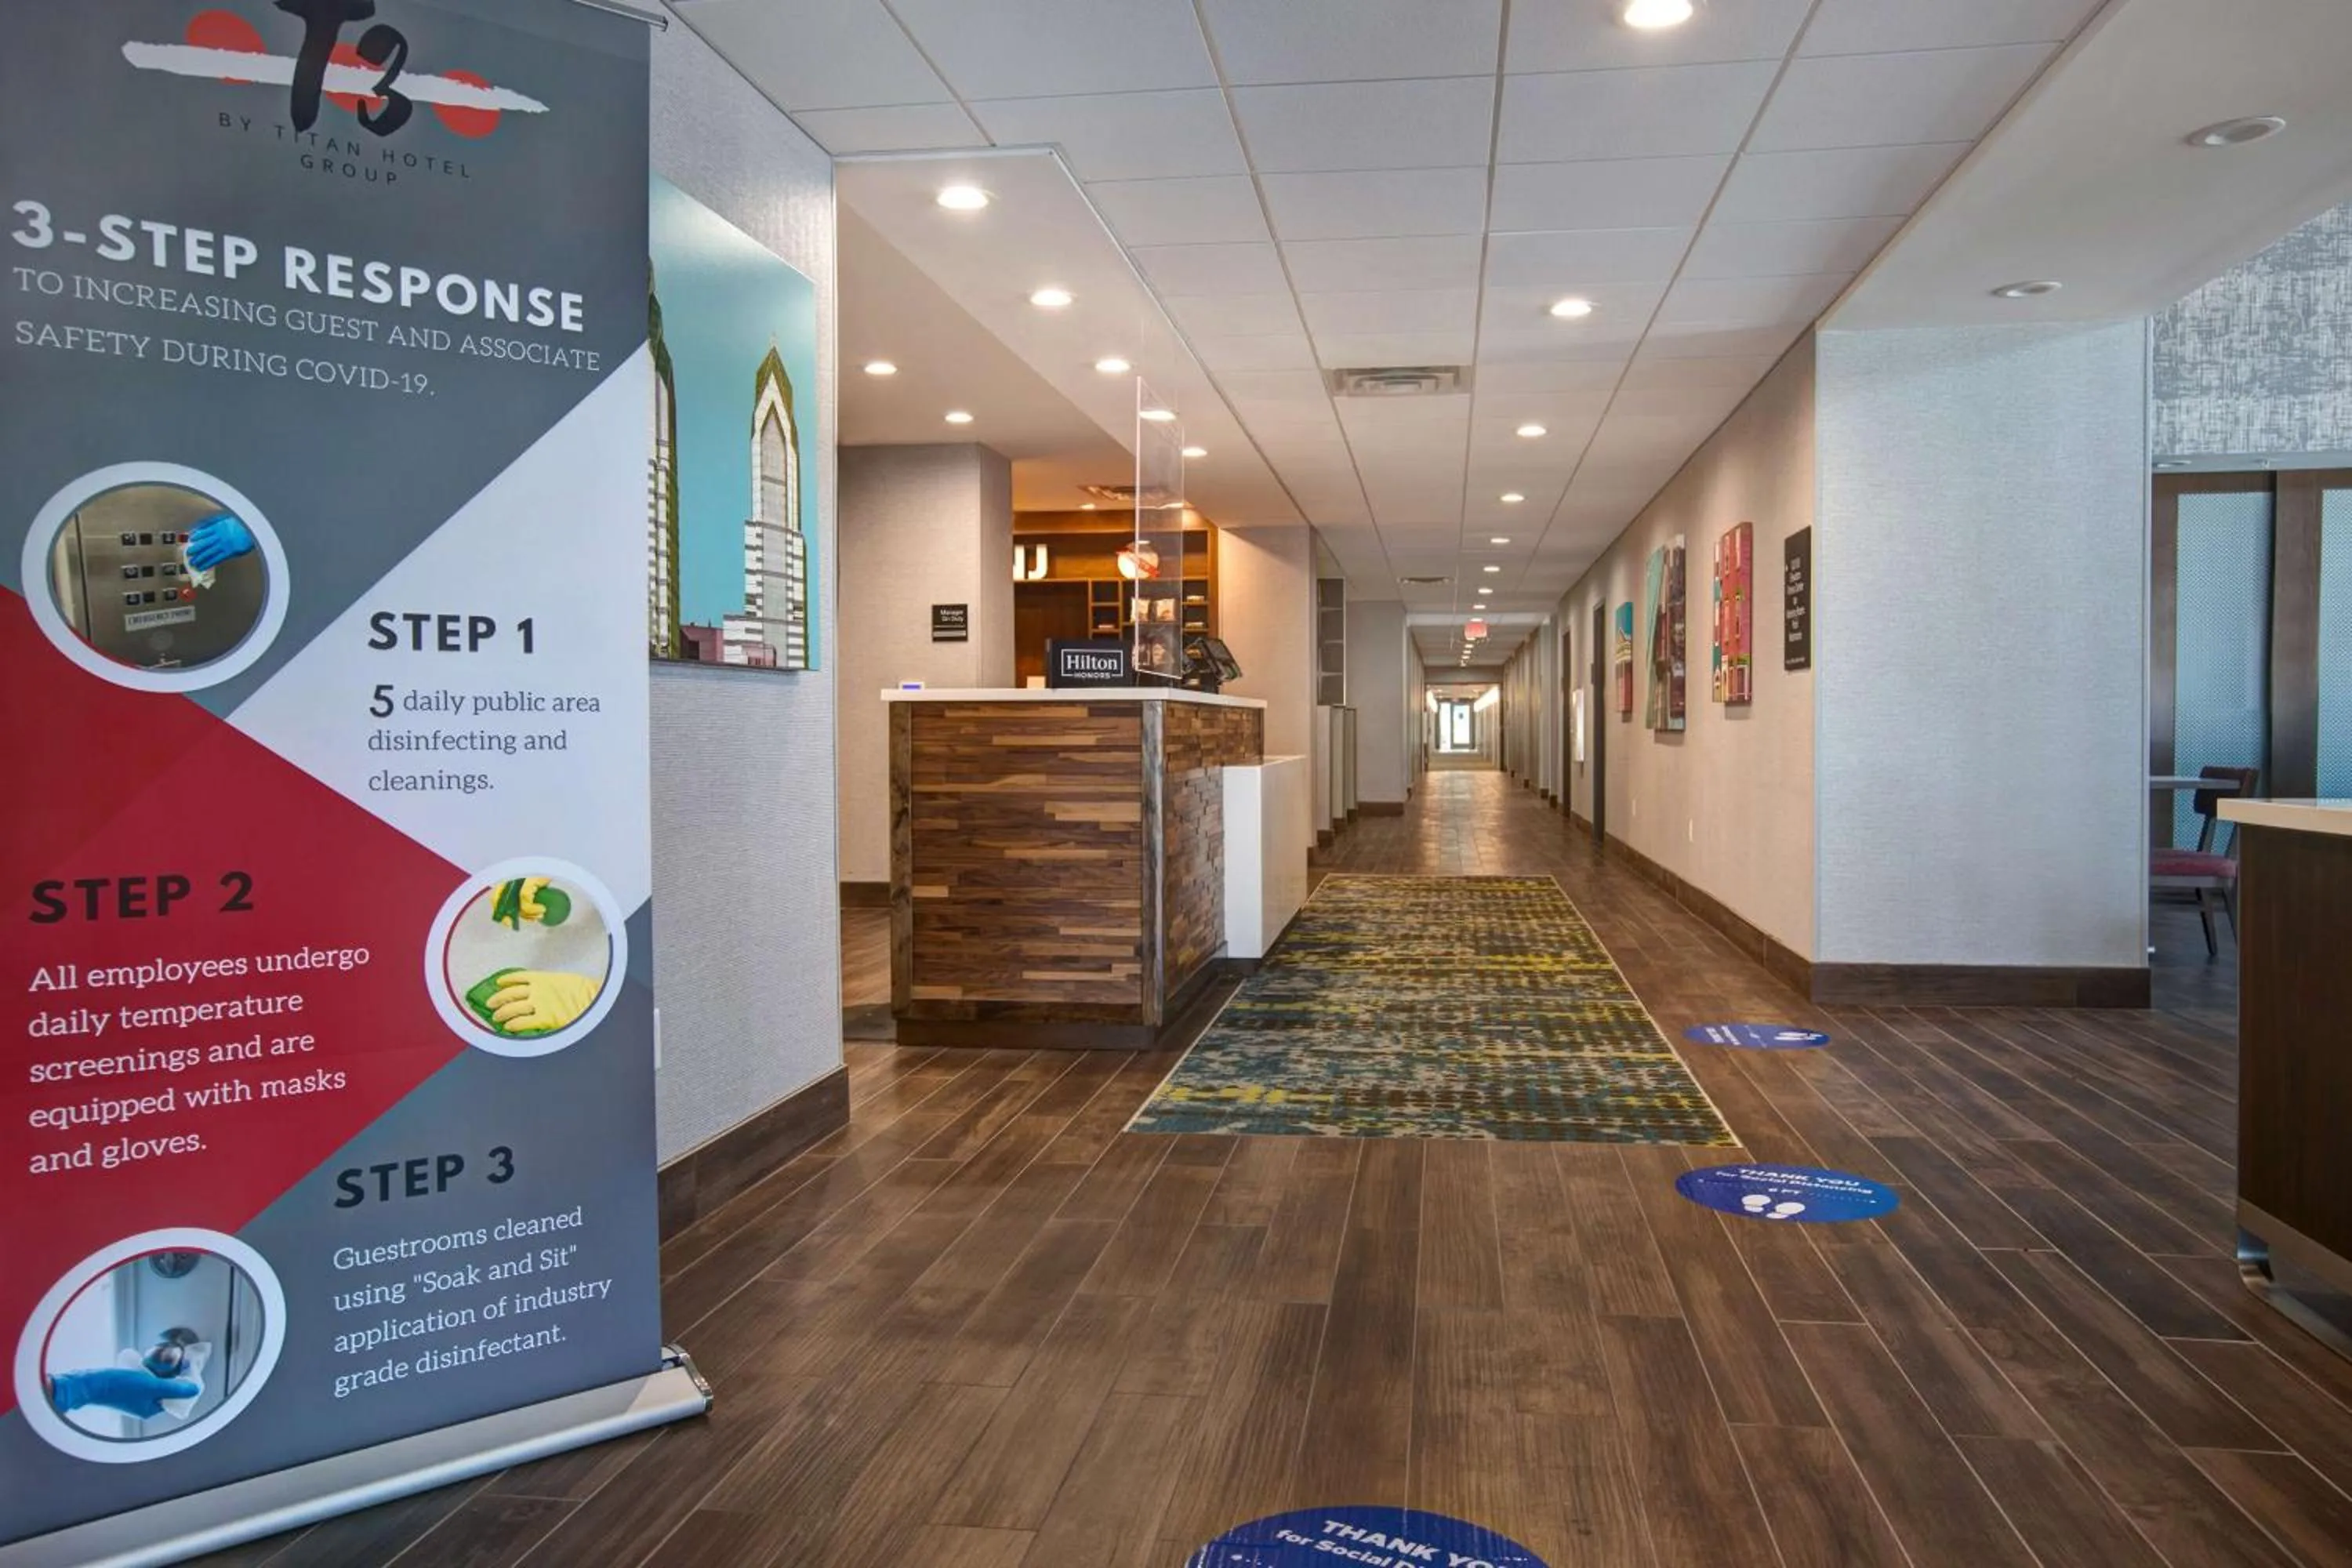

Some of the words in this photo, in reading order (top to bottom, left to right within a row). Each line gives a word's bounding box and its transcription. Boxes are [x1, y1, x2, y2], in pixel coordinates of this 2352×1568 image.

[273, 0, 413, 136] T3
[219, 112, 252, 131] BY
[274, 125, 361, 157] TITAN
[383, 149, 470, 178] HOTEL
[300, 154, 397, 185] GROUP
[11, 200, 258, 279] 3-STEP
[285, 245, 583, 332] RESPONSE
[13, 267, 64, 295] TO
[74, 275, 277, 327] INCREASING
[285, 309, 379, 342] GUEST
[387, 325, 451, 351] AND
[459, 334, 601, 372] ASSOCIATE
[15, 320, 151, 358] SAFETY
[162, 339, 287, 377] DURING
[296, 358, 435, 395] COVID-19.
[368, 612, 496, 652] STEP
[517, 617, 533, 654] 1
[1067, 655, 1118, 670] Hilton
[369, 684, 394, 718] 5
[403, 690, 466, 716] daily
[472, 691, 546, 716] public
[552, 696, 601, 713] area
[368, 730, 517, 755] disinfecting
[523, 730, 567, 751] and
[368, 769, 495, 794] cleanings.
[28, 874, 191, 924] STEP
[219, 871, 254, 913] 2
[28, 964, 78, 992] All
[87, 956, 249, 989] employees
[256, 946, 370, 974] undergo
[28, 1008, 111, 1038] daily
[119, 993, 304, 1030] temperature
[30, 1046, 200, 1084] screenings
[208, 1034, 262, 1063] and
[270, 1033, 316, 1056] are
[28, 1088, 176, 1130] equipped
[185, 1080, 252, 1109] with
[260, 1069, 347, 1100] masks
[30, 1142, 93, 1174] and
[102, 1132, 208, 1170] gloves.
[334, 1153, 465, 1208] STEP
[486, 1145, 515, 1184] 3
[1739, 1168, 1809, 1181] THANK
[1816, 1177, 1860, 1186] YOU
[333, 1226, 487, 1270] Guestrooms
[494, 1205, 583, 1239] cleaned
[333, 1281, 406, 1312] using
[413, 1265, 482, 1294] "Soak
[488, 1253, 533, 1281] and
[539, 1244, 577, 1270] Sit"
[334, 1306, 477, 1355] application
[483, 1296, 507, 1321] of
[514, 1277, 612, 1315] industry
[333, 1359, 409, 1399] grade
[416, 1323, 567, 1374] disinfectant.
[1276, 1530, 1314, 1545] for
[1314, 1540, 1393, 1568] Social
[1323, 1520, 1441, 1561] THANK
